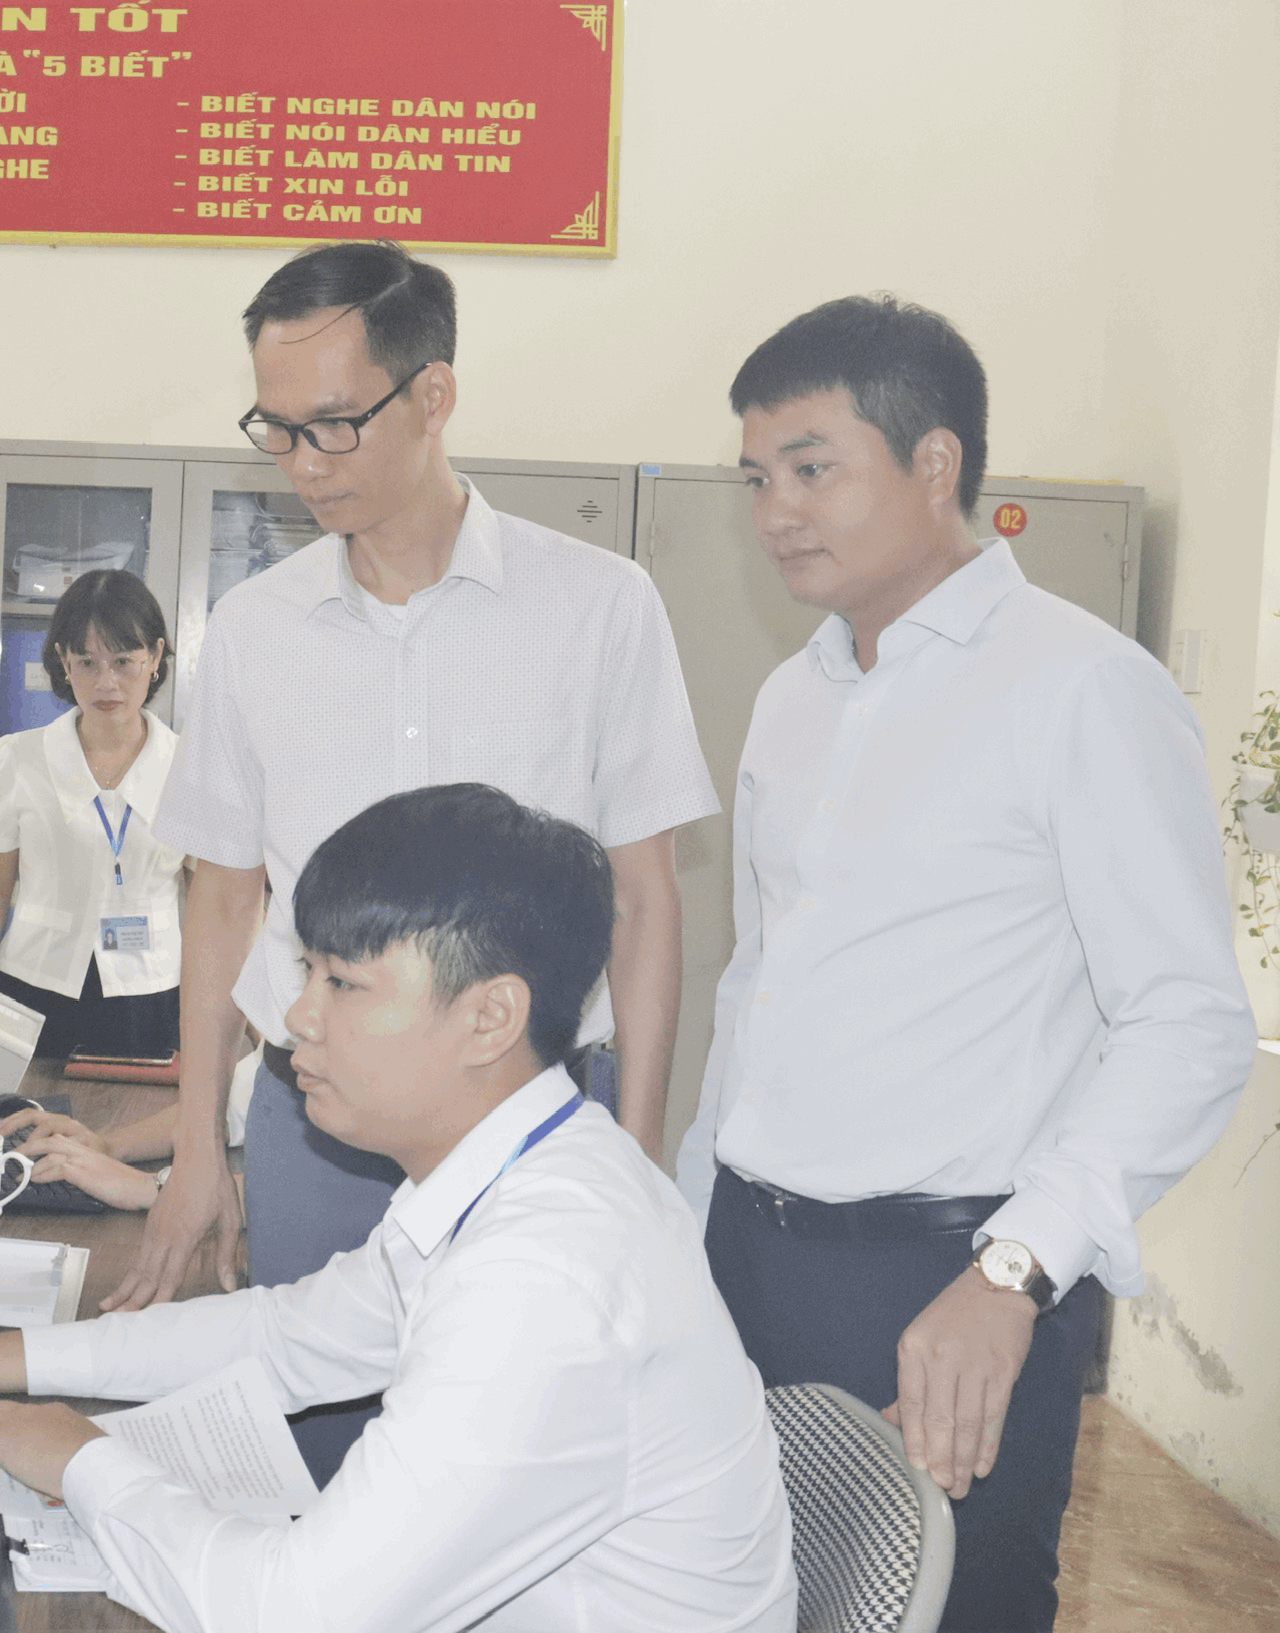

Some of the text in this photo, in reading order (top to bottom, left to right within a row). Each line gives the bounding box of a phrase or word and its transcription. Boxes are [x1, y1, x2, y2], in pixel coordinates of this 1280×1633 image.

[70, 0, 188, 33] TỐT
[201, 92, 536, 119] BIẾT NGHE DÂN NÓI
[200, 118, 521, 145] BIẾT NÓI DÂN HIỂU
[199, 145, 511, 173] BIẾT LÀM DÂN TIN
[198, 172, 408, 196] BIẾT XIN LỖI
[197, 198, 422, 224] BIẾT CẢM ƠN
[1000, 507, 1022, 529] 02
